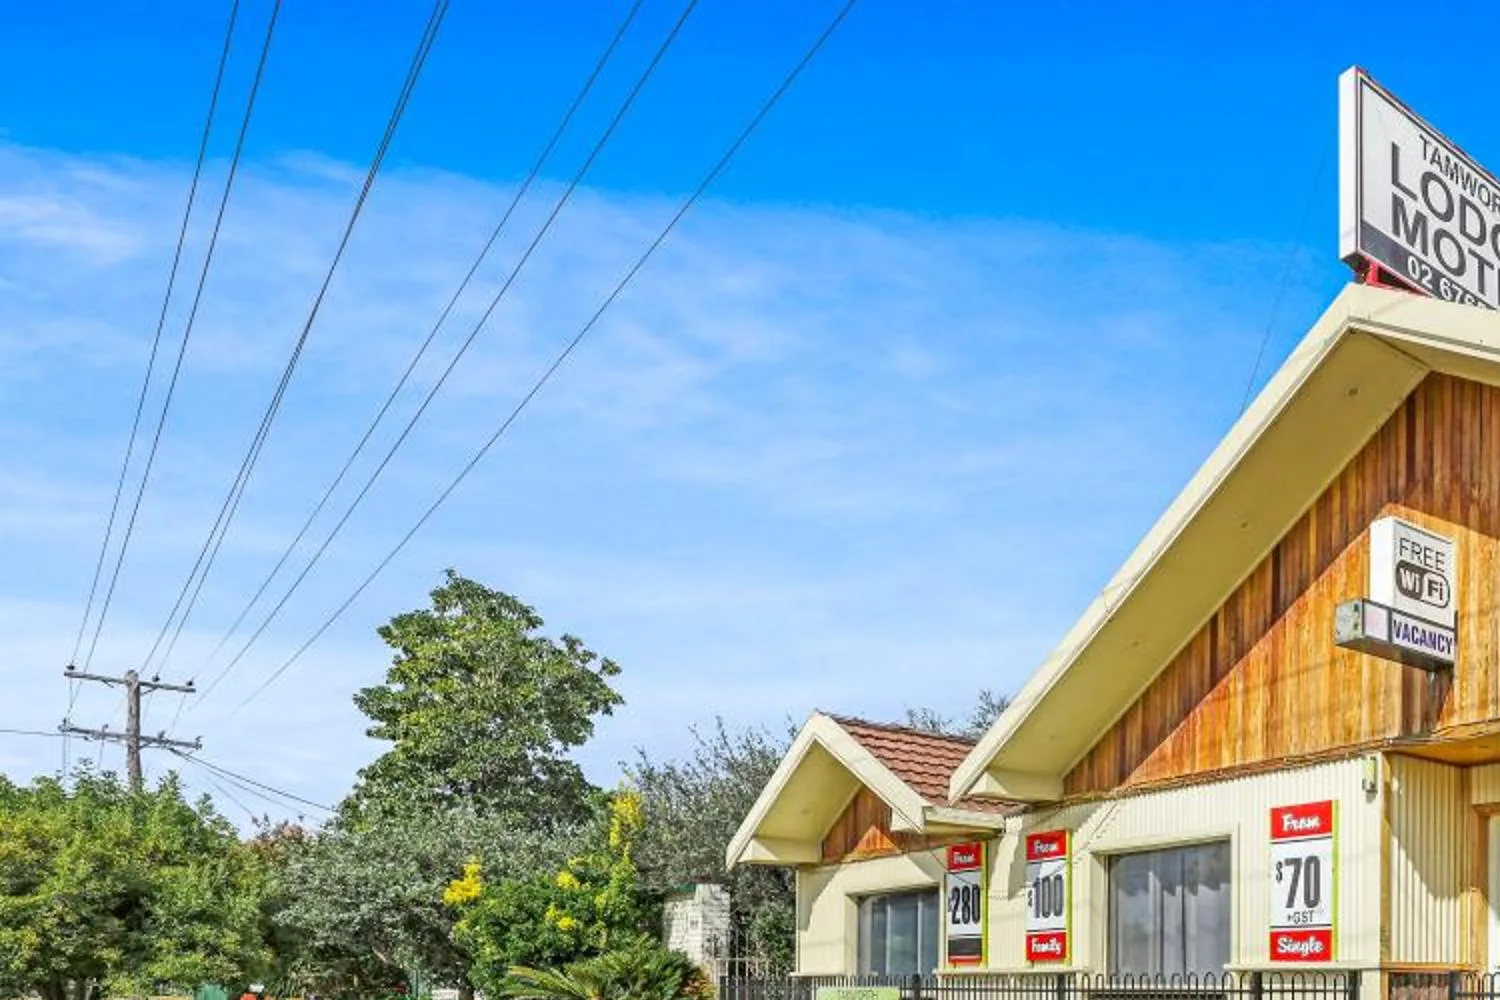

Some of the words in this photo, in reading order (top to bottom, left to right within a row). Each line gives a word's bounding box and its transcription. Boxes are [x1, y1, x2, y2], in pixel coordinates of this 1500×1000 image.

[1407, 255, 1433, 289] 02
[1440, 277, 1486, 307] 67
[1399, 537, 1446, 573] FREE
[1393, 619, 1453, 655] VACANCY
[1281, 813, 1322, 832] From
[1028, 874, 1064, 919] $100
[1275, 855, 1321, 909] $70
[1287, 910, 1315, 925] +GST
[1276, 935, 1324, 957] Single
